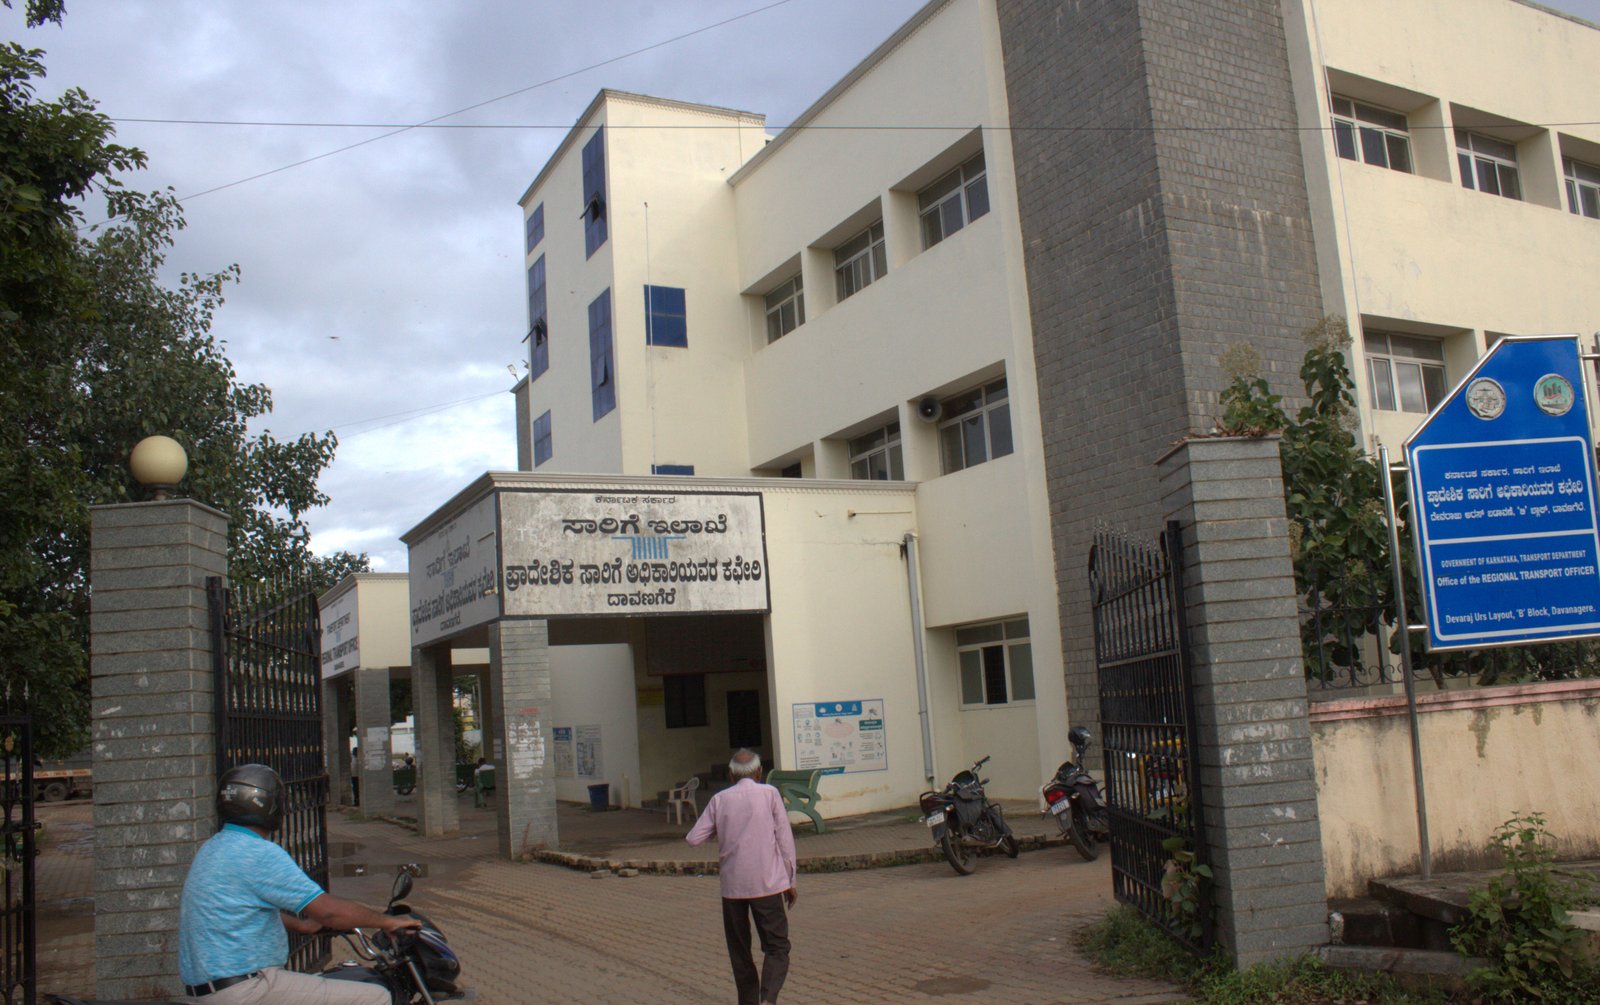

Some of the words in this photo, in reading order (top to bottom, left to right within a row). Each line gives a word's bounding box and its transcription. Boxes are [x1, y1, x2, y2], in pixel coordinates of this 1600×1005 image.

[1426, 486, 1464, 508] ಪ್ರಾದೇಶಿಕ
[1467, 483, 1493, 500] ಸಾರಿಗೆ
[1496, 480, 1554, 500] ಅಧಿಕಾರಿಯವರ
[562, 514, 640, 534] ಸಾರಿಗೆ
[647, 514, 728, 534] ಇಲಾಖೆ
[1440, 557, 1477, 568] GOVERNMENT
[1477, 557, 1485, 566] OF
[1486, 555, 1519, 565] KARNATAKA,
[1520, 552, 1551, 562] TRANSPORT
[1552, 550, 1586, 560] DEPARTMENT
[506, 558, 574, 591] ಪ್ರಾದೇಶಿಕ
[580, 557, 622, 585] ಸಾರಿಗೆ
[626, 556, 718, 587] ಅಧಿಕಾರಿಯವರ
[722, 555, 761, 584] ಕಛೇರಿ
[1437, 576, 1458, 587] Office
[1460, 576, 1467, 585] of
[1469, 574, 1480, 585] the
[1482, 572, 1519, 583] REGIONAL
[1520, 568, 1563, 580] TRANSPORT
[1564, 565, 1596, 577] OFFICER
[607, 588, 676, 607] ದಾವಣಗೆರೆ
[1445, 614, 1474, 625] Devaraj
[1474, 612, 1487, 622] Urs
[1488, 610, 1515, 622] Layout,
[1527, 607, 1550, 618] Block,
[1551, 604, 1596, 616] Davanagere.
